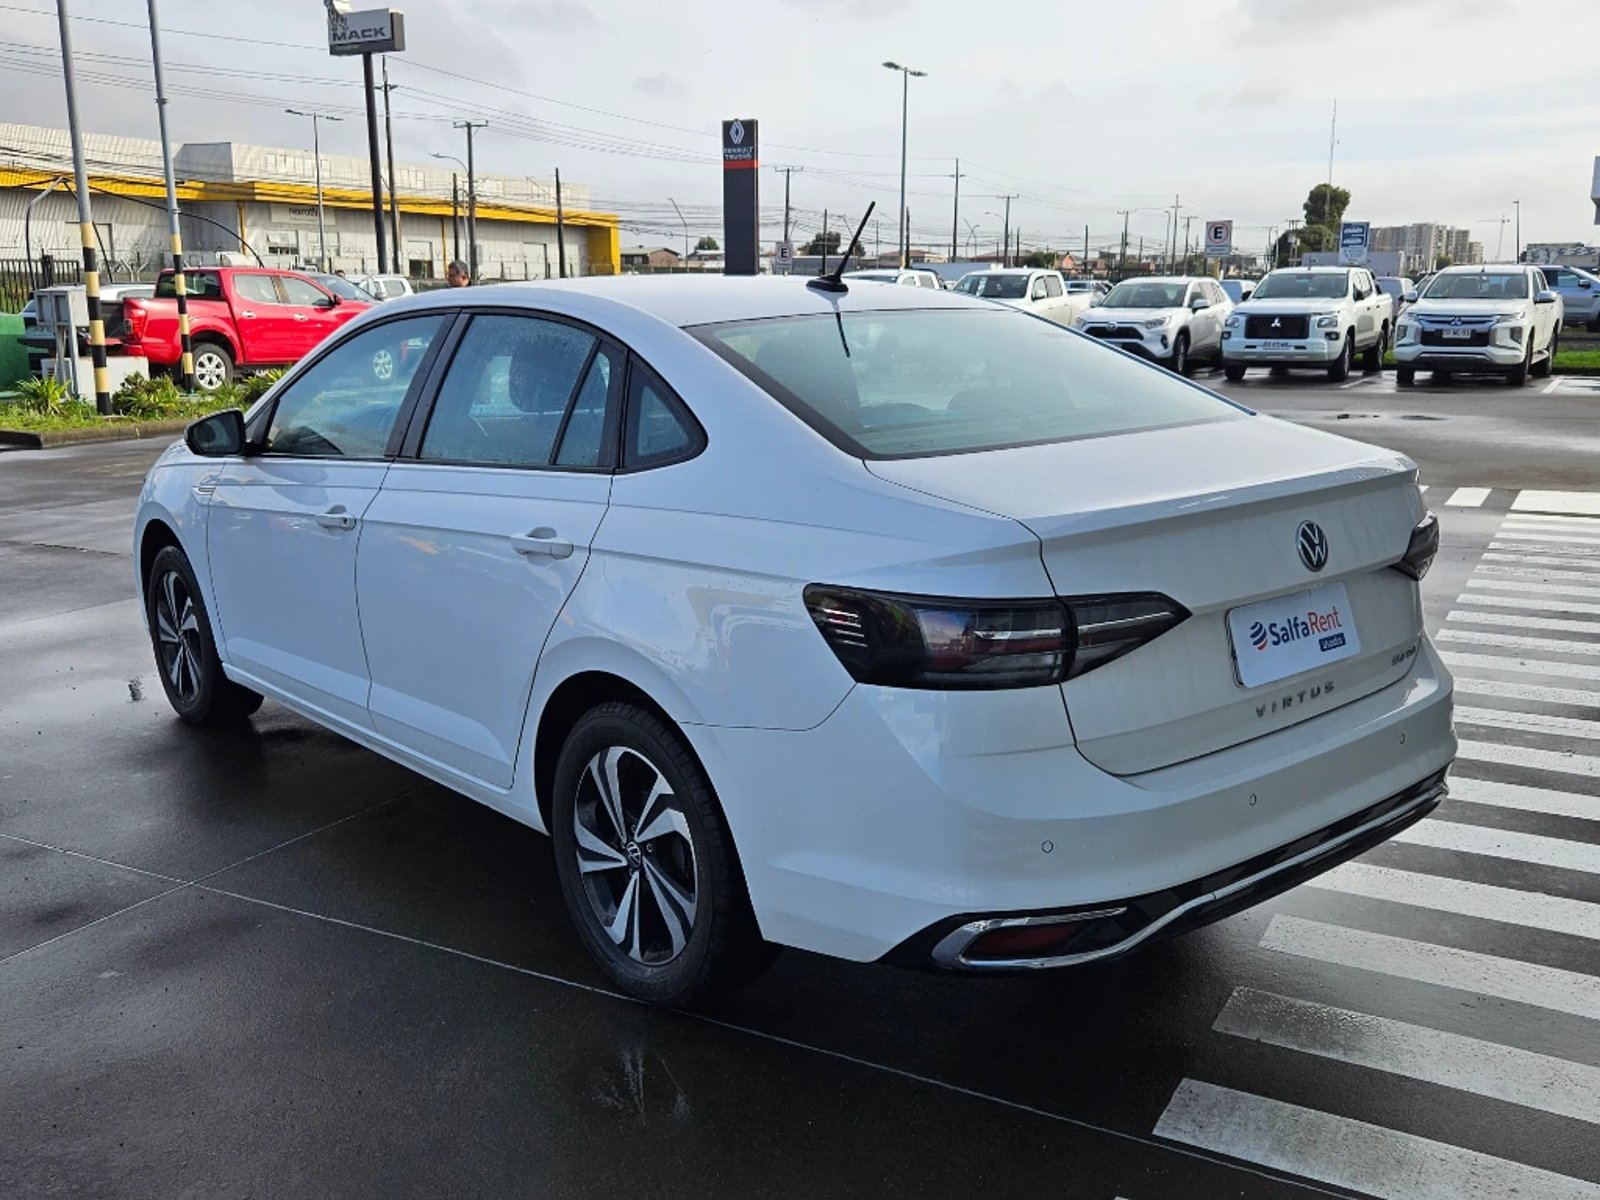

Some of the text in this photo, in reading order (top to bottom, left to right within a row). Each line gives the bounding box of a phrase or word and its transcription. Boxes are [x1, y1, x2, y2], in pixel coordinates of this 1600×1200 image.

[332, 27, 386, 41] MACK
[1214, 226, 1223, 239] E
[781, 248, 788, 259] E
[1268, 606, 1343, 646] SalfaRent
[1256, 681, 1335, 717] VIRTUS
